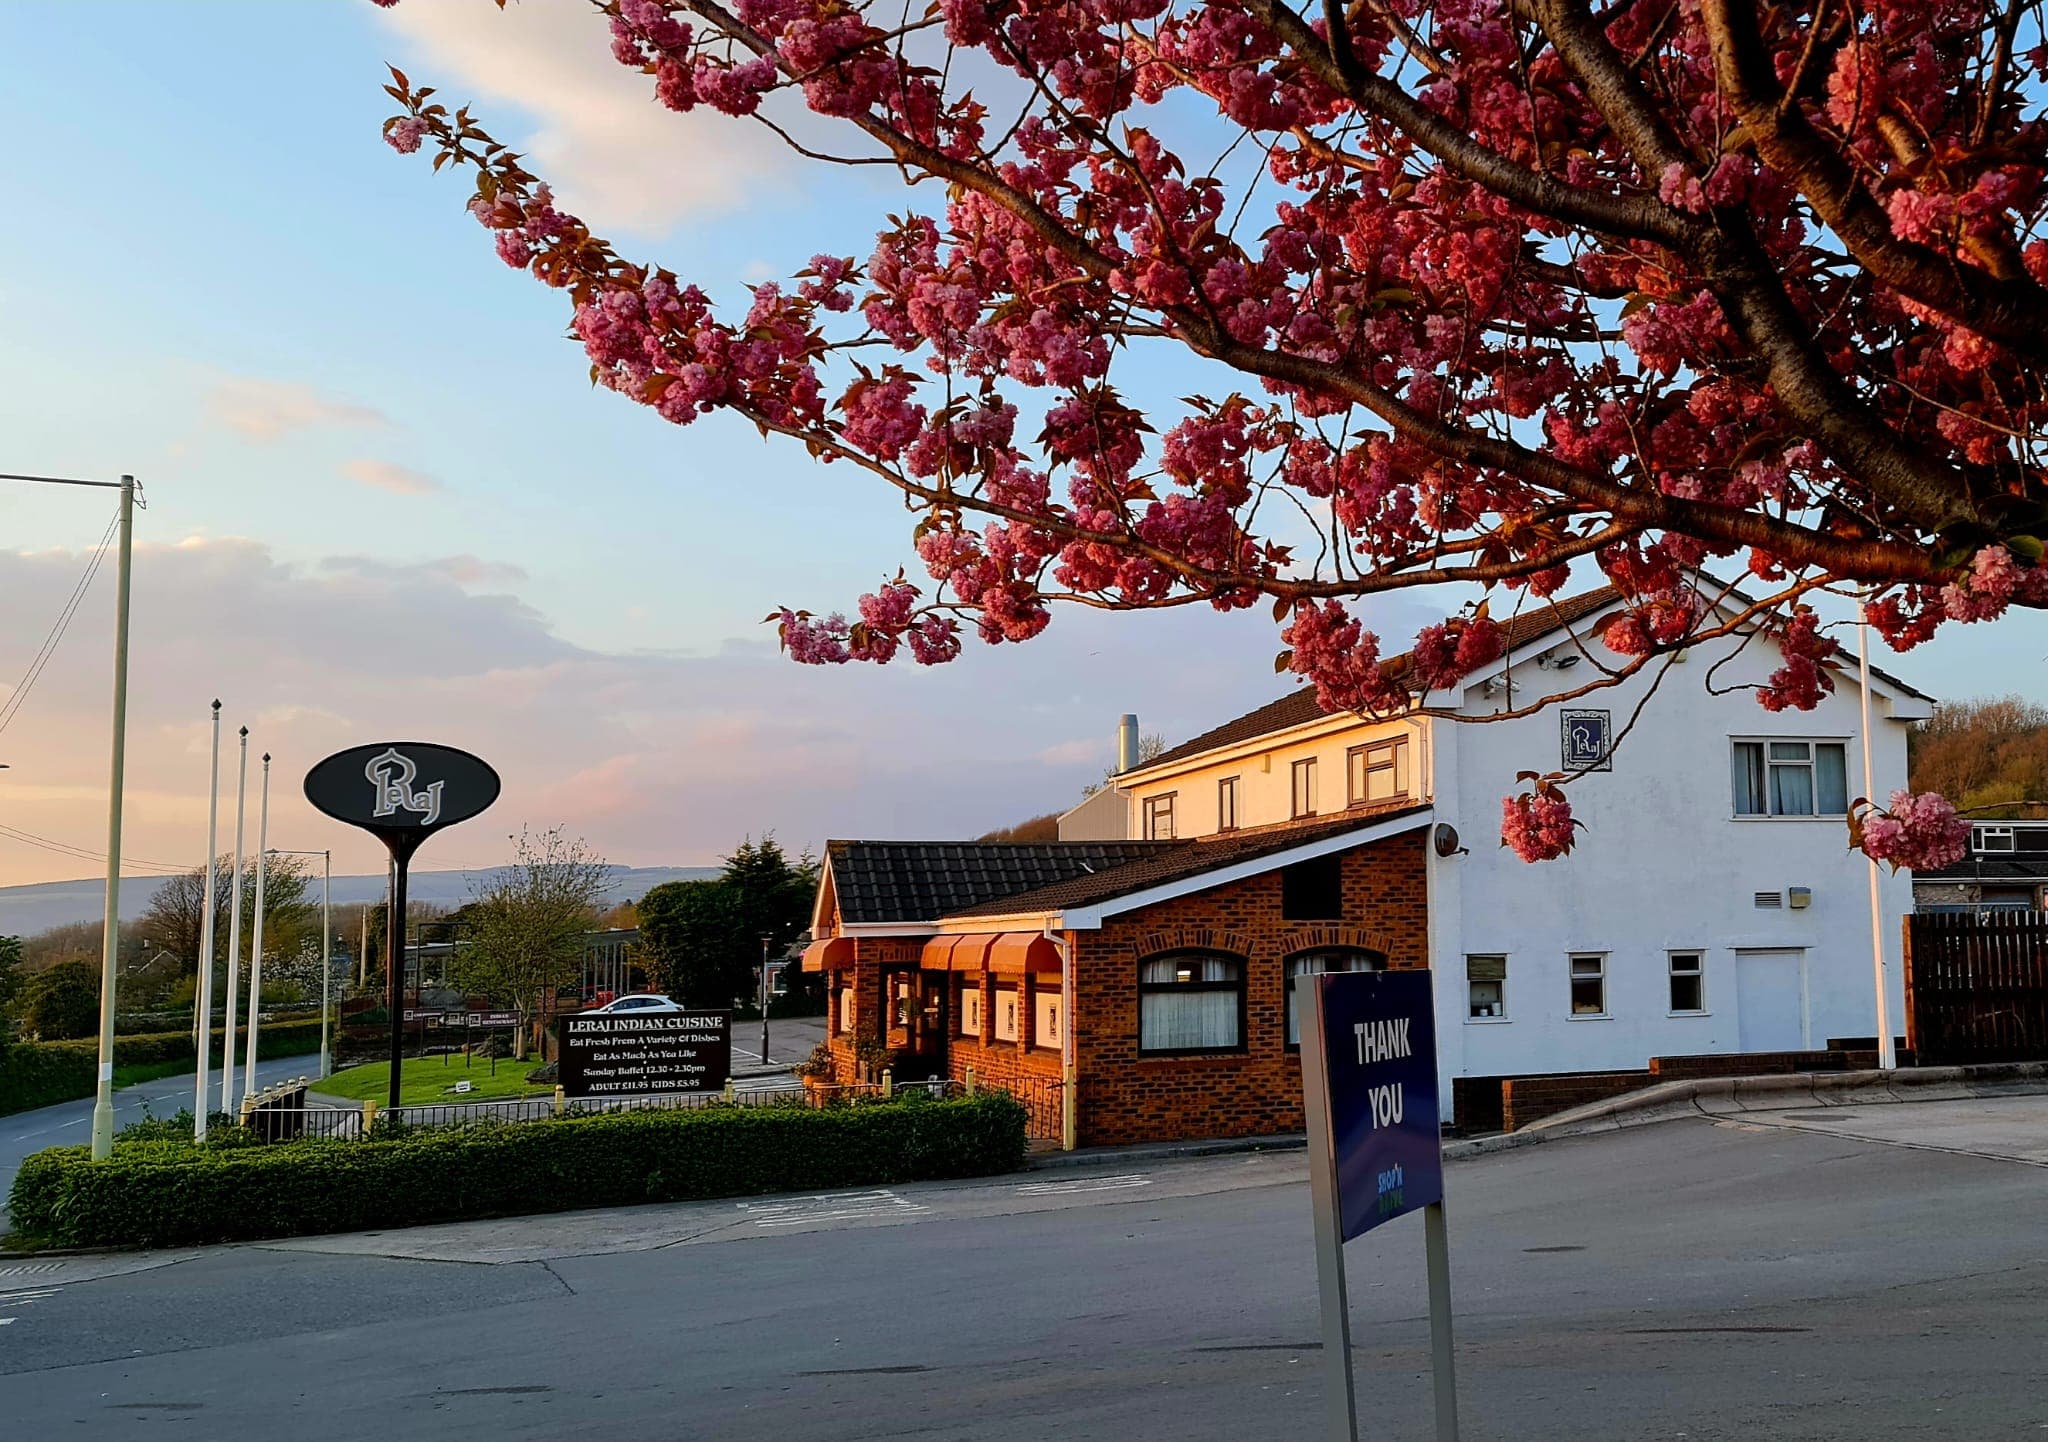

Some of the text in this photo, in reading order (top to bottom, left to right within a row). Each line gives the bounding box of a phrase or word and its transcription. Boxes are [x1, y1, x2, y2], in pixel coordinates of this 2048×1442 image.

[568, 1016, 723, 1033] LERAJ INDIAN CUISINE
[570, 1033, 720, 1047] Eat Fresh From A Variety Of Dishes
[1354, 1017, 1411, 1065] THANK
[593, 1050, 697, 1061] Eat As Much As You Like
[583, 1067, 616, 1077] Sunday
[618, 1066, 644, 1075] Buffet
[646, 1065, 668, 1074] 12.30
[674, 1064, 706, 1074] 2.30pm
[588, 1079, 700, 1092] ADULT £11.95 KIDS £5.95
[1368, 1082, 1404, 1129] YOU
